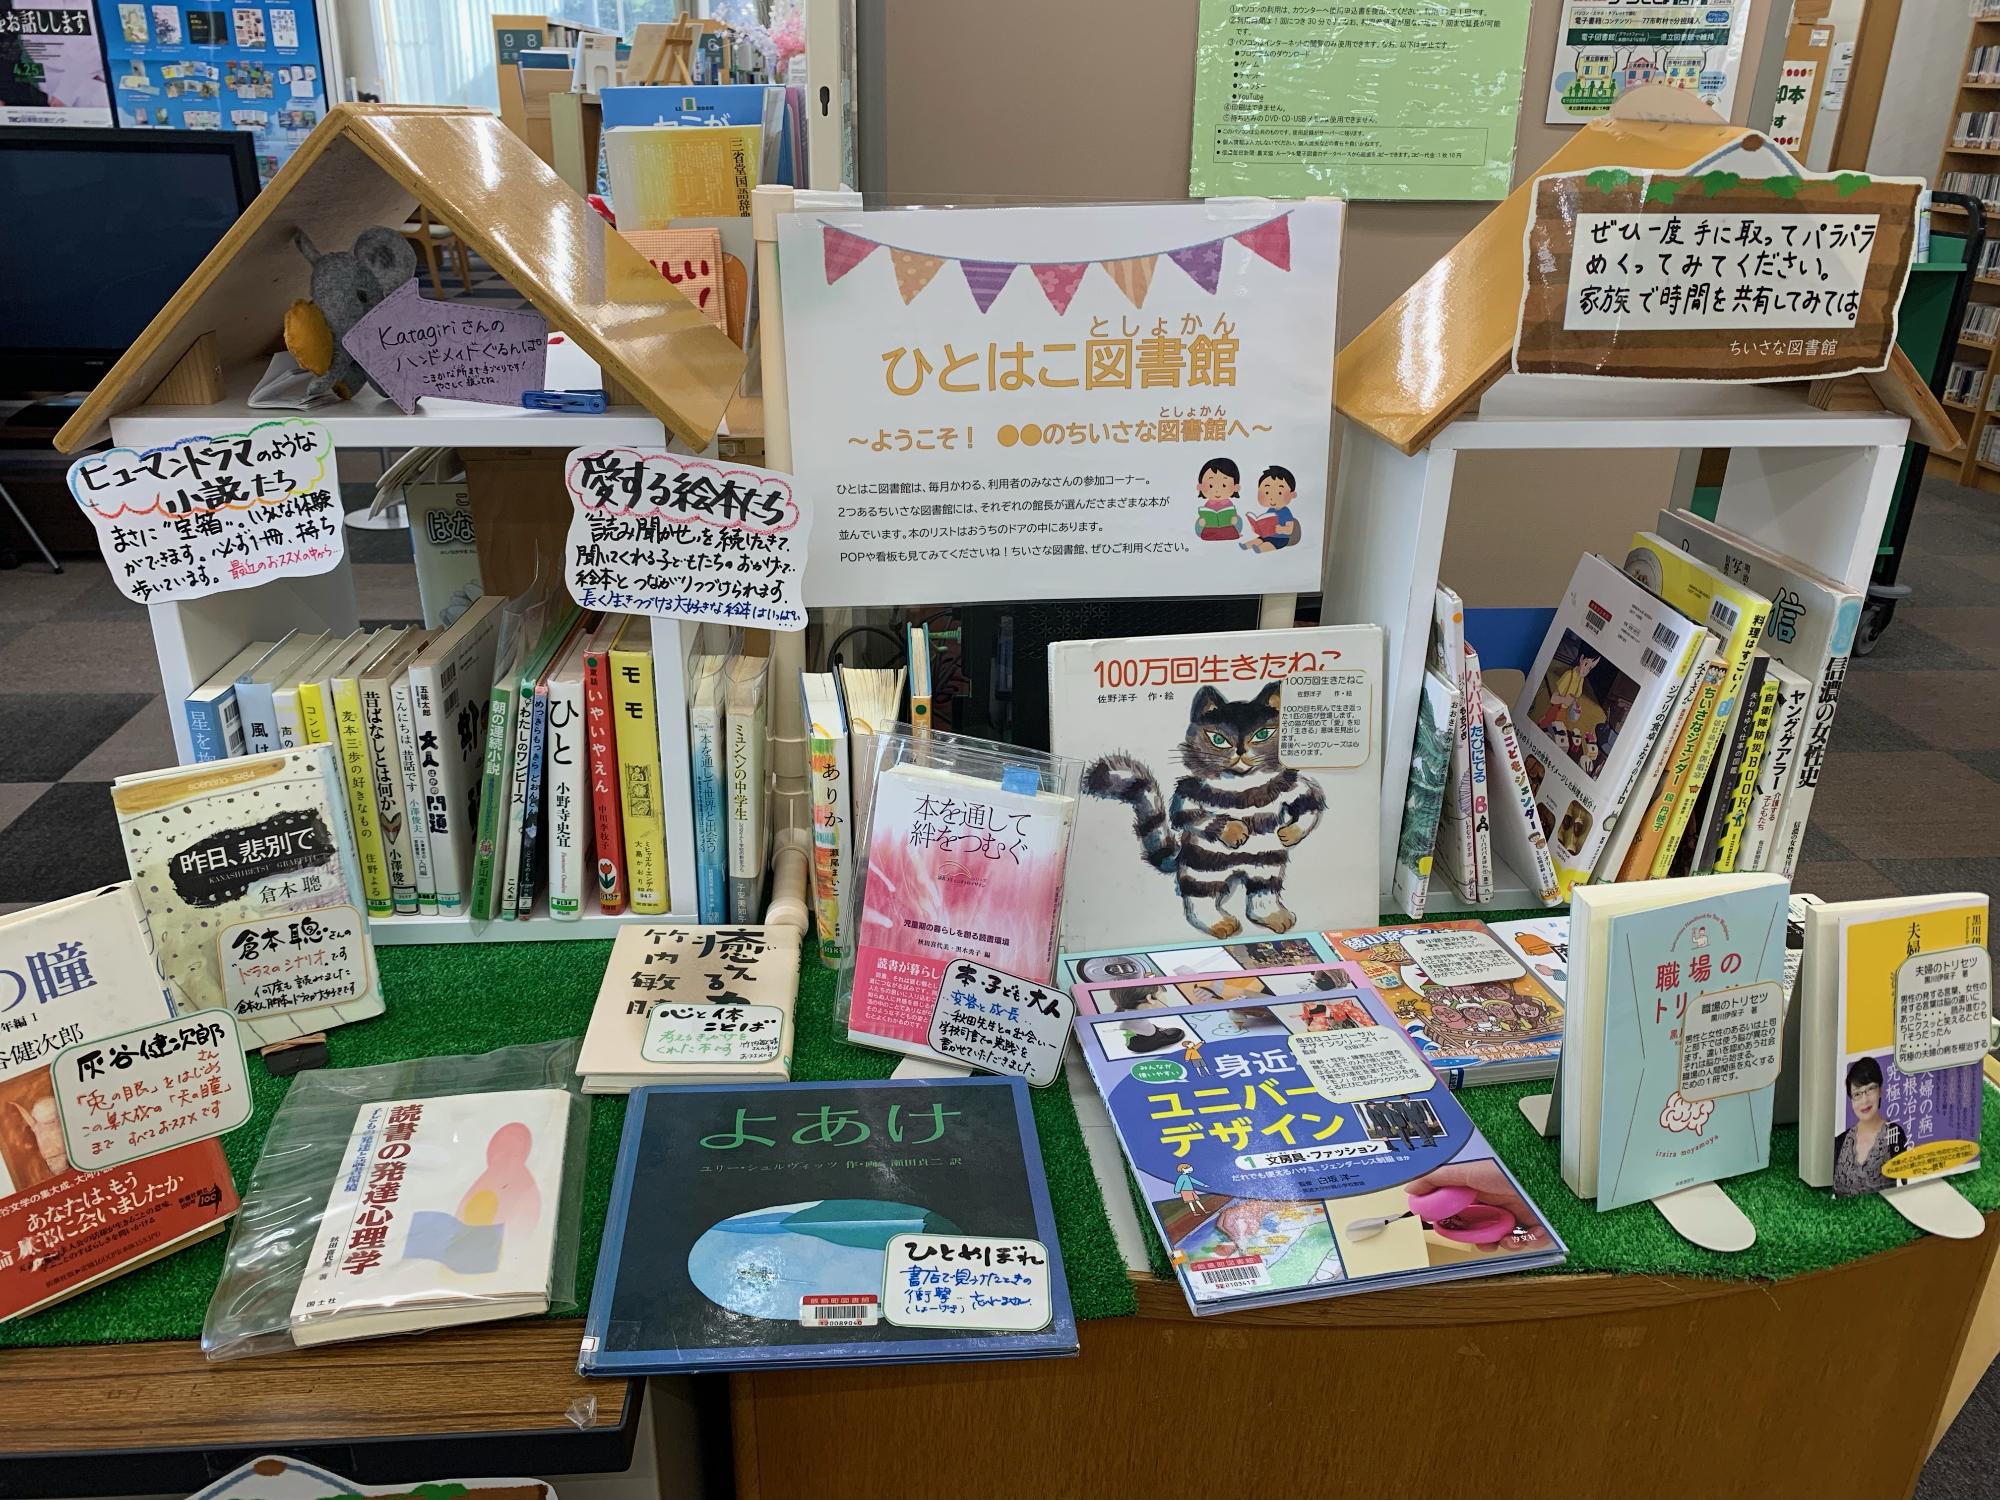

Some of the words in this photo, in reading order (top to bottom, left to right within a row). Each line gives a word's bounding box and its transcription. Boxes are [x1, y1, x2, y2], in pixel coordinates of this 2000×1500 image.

[503, 33, 514, 48] 9
[527, 33, 537, 48] 8
[707, 38, 719, 52] 6
[1585, 251, 1829, 281] めくってみてください。
[1088, 312, 1237, 338] としょかん
[1729, 338, 1839, 357] ちいさな図書館
[881, 333, 1240, 397] ひとはこ図書館
[1159, 405, 1227, 418] としょかん
[80, 431, 318, 491] ヒューマンドラマのような
[166, 470, 296, 513] 小説たち
[577, 450, 785, 526] 愛する絵本たち
[836, 474, 1150, 495] ひとはこ図書館は、毎月かわる、利用者のみなさんの参加コーナー。
[838, 495, 1170, 518] 2つあるちいさな図書館には、それぞれの館長が選んださまざまな本が
[838, 520, 1104, 541] 並んでいます。本のリストはおうちのドアの中にあります。
[840, 541, 1190, 564] POPや看板も見てみてくださいね！ちいさな図書館、ぜひご利用ください。
[1768, 586, 1807, 643] 信
[1094, 650, 1341, 689] 100万回生きたねこ
[1729, 614, 1767, 693] 料理はすごい！
[420, 685, 431, 717] 五味太郎
[622, 666, 643, 719] モモ
[1097, 693, 1138, 703] 佐野洋子
[1148, 690, 1174, 702] 作・絵
[1285, 676, 1364, 685] 100万回生きたねこ
[395, 690, 417, 794] こんにちは、昔話です
[486, 700, 506, 777] 朝の連続小説
[550, 700, 579, 765] ひと
[588, 690, 608, 794] いやいやえん
[1672, 686, 1718, 786] ちいさなジェンダー
[1796, 656, 1848, 789] 信濃の女性史
[363, 691, 396, 811] 昔ばなしとは何か
[512, 706, 532, 804] わたしのワンピース
[734, 725, 748, 821] ミュンヘンの中学生
[1470, 725, 1485, 784] たびにでる
[1737, 693, 1775, 808] 自衛隊防災BOOK
[342, 710, 372, 839] 麦本三歩の好きなもの
[700, 733, 719, 854] 本を通して世界と出会う
[822, 763, 843, 828] ありか
[556, 782, 571, 848] 小野寺史宜
[916, 794, 1032, 836] 本を通して
[180, 827, 317, 875] 昨日、悲別で
[909, 820, 1029, 865] 絆をつむぐ
[259, 882, 298, 904] 倉本
[366, 852, 381, 897] 住野よる
[829, 848, 839, 897] 瀬尾まいこ
[903, 919, 1010, 947] 児童期の暮らしを創る読書環境
[1656, 952, 1742, 992] 職場の
[1915, 957, 1978, 976] 夫婦のトリセツ
[955, 964, 1061, 1019] 本・子ども・大人
[1701, 992, 1769, 1014] 職場のトリセツ
[660, 1008, 745, 1022] 心と体
[704, 1019, 776, 1032] ことば
[77, 1024, 225, 1082] 灰谷健次郎
[198, 1050, 219, 1060] さん
[1139, 1062, 1173, 1071] みんなが
[1215, 1048, 1301, 1079] 身近
[1148, 1077, 1317, 1120] ユニバー
[1886, 1063, 1900, 1152] 究極の一冊。
[700, 1103, 961, 1150] よあけ
[1160, 1113, 1345, 1158] デザイン
[1243, 1156, 1258, 1168] 1
[1266, 1143, 1379, 1166] 文房具・ファッション
[27, 1172, 137, 1232] あなたは、もう
[342, 1104, 424, 1275] 読書の発達心理学
